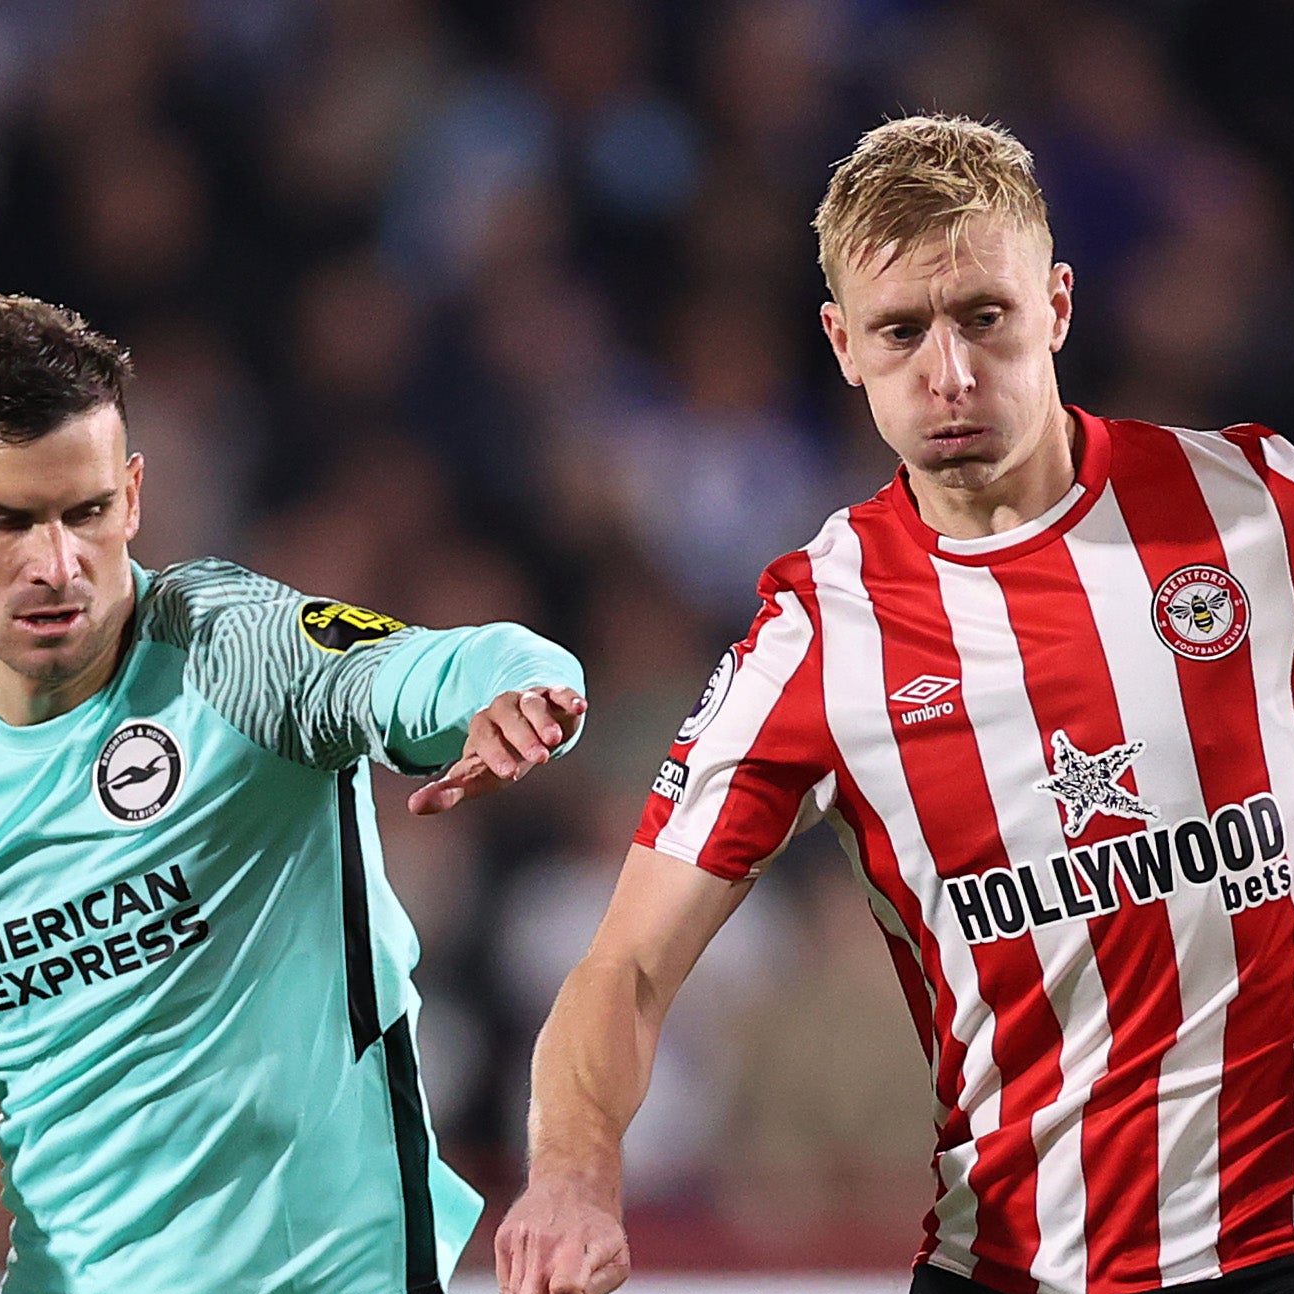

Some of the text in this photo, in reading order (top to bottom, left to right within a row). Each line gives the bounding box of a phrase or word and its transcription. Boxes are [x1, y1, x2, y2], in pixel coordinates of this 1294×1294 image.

[1160, 570, 1226, 603] BRENTFORD
[1174, 623, 1243, 655] FOOTBALL CLUB
[901, 702, 954, 725] umbro
[100, 728, 135, 767] BRIGHTON
[146, 728, 168, 745] HOVE
[127, 801, 162, 820] ALBION
[947, 796, 1286, 941] HOLLYWOOD
[1219, 862, 1292, 911] bets
